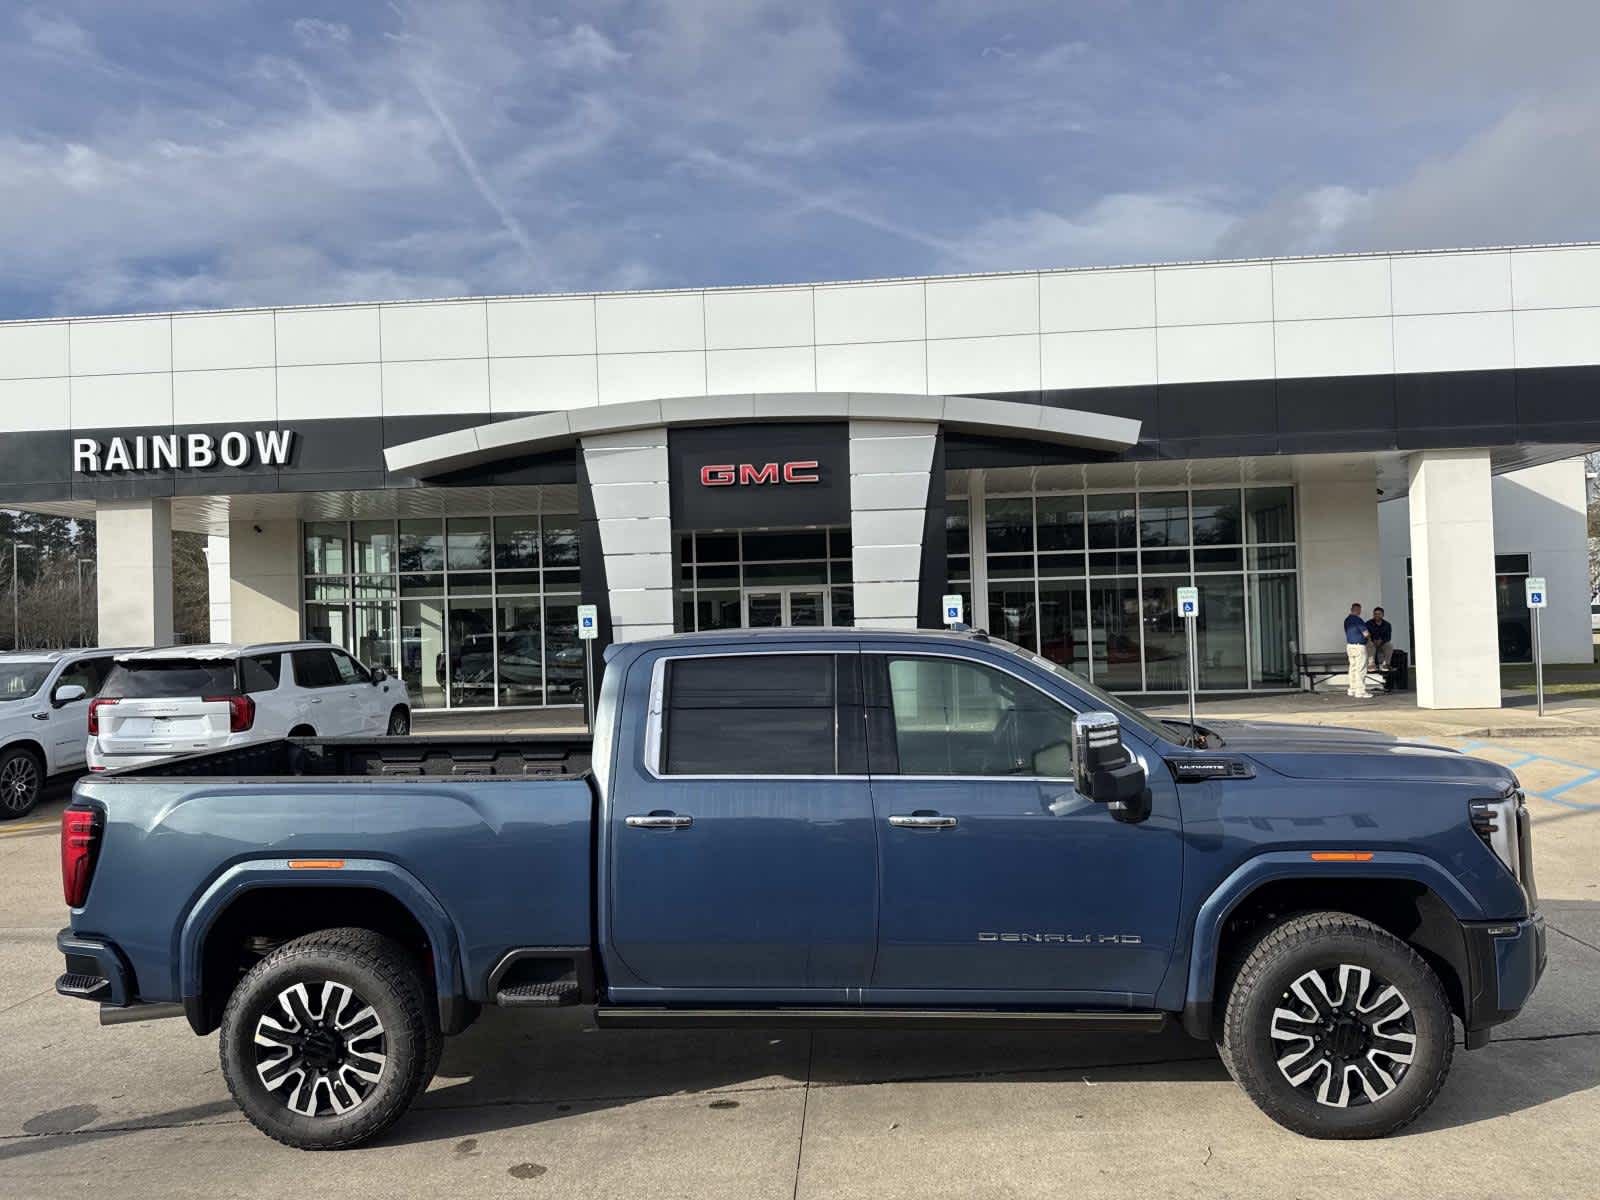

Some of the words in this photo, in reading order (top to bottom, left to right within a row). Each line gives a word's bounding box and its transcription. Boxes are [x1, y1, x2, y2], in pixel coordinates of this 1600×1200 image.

[73, 430, 291, 472] RAINBOW
[701, 461, 819, 486] GMC
[977, 932, 1091, 943] DENALI
[1098, 934, 1142, 944] HD
